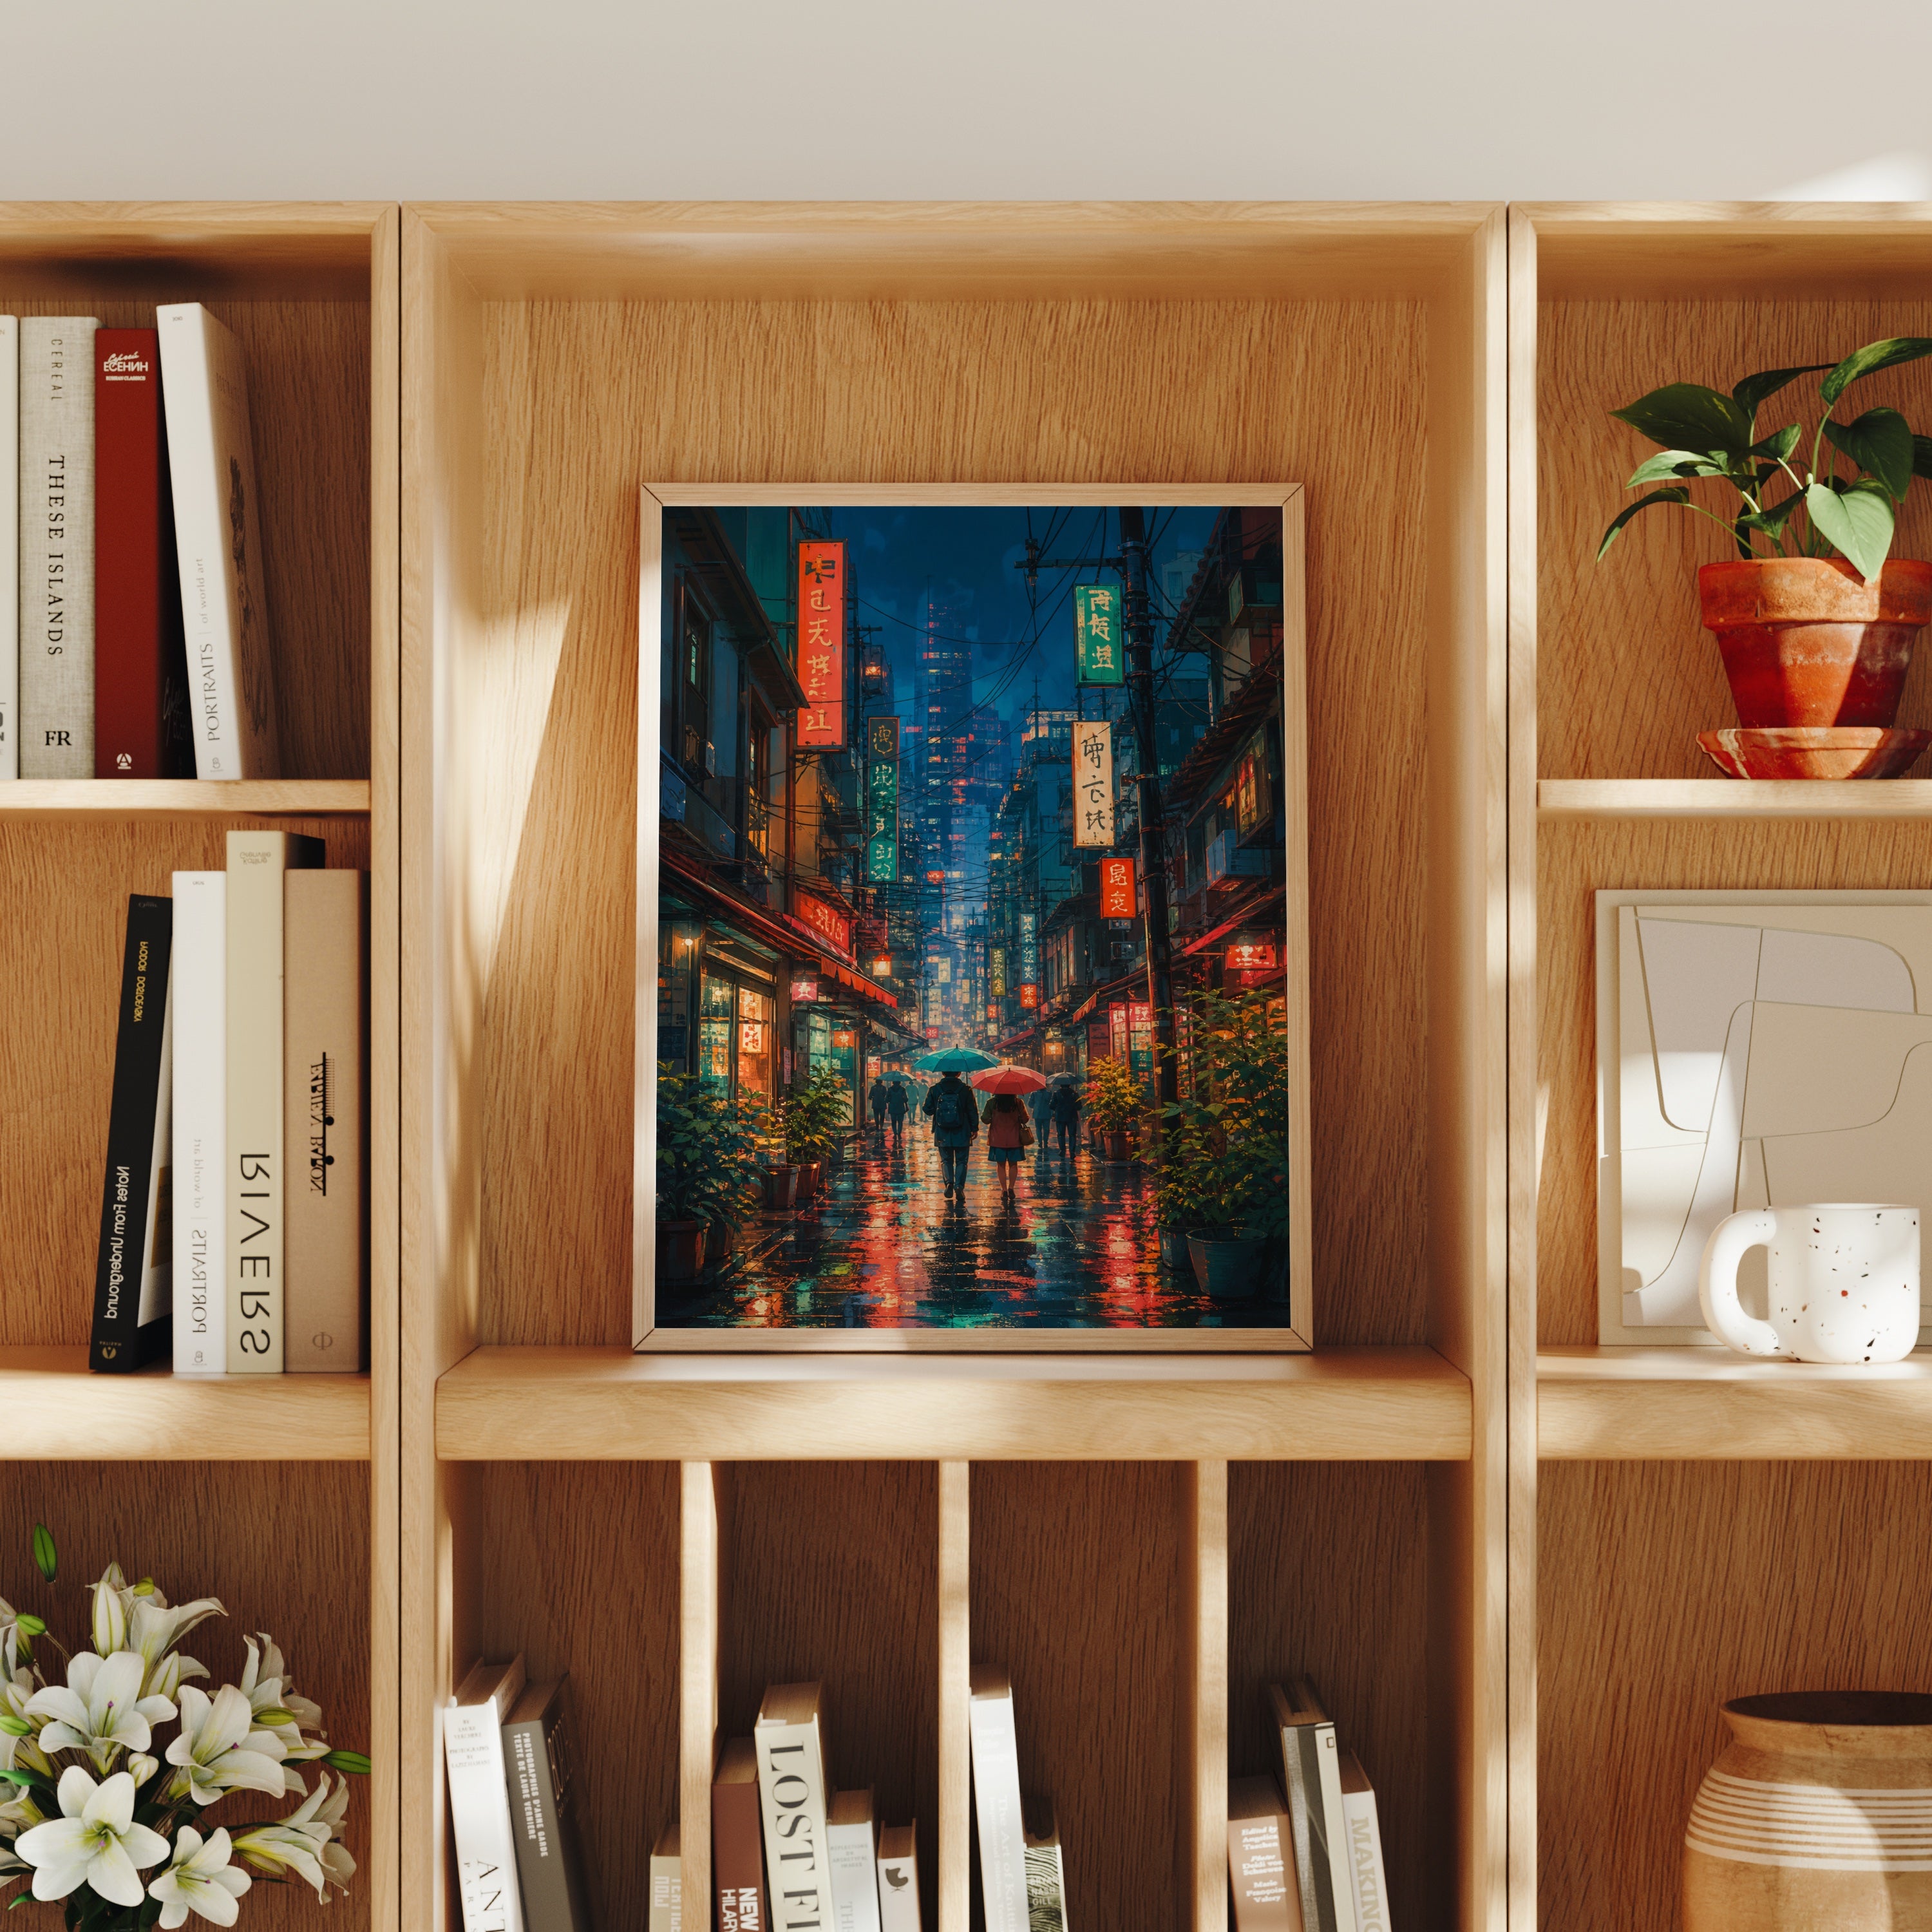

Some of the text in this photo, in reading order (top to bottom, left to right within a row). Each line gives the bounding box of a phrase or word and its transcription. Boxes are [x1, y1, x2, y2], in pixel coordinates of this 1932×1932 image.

[52, 339, 62, 401] CEREAL
[103, 361, 149, 372] ЕСЕНИН
[48, 455, 64, 655] THESE ISLANDS
[196, 576, 207, 606] world
[200, 612, 209, 623] of
[200, 643, 220, 741] PORTRAITS
[45, 731, 72, 746] FR
[514, 1734, 524, 1759] TEXTE
[517, 1760, 526, 1771] DE
[519, 1774, 530, 1799] LAURE
[522, 1732, 548, 1857] PHOTOGRAPHIES D'ANNE GARDE
[769, 1741, 815, 1871] LOST
[654, 1876, 670, 1908] NOW
[1032, 1897, 1052, 1906] GILL
[739, 1888, 759, 1931] NEW
